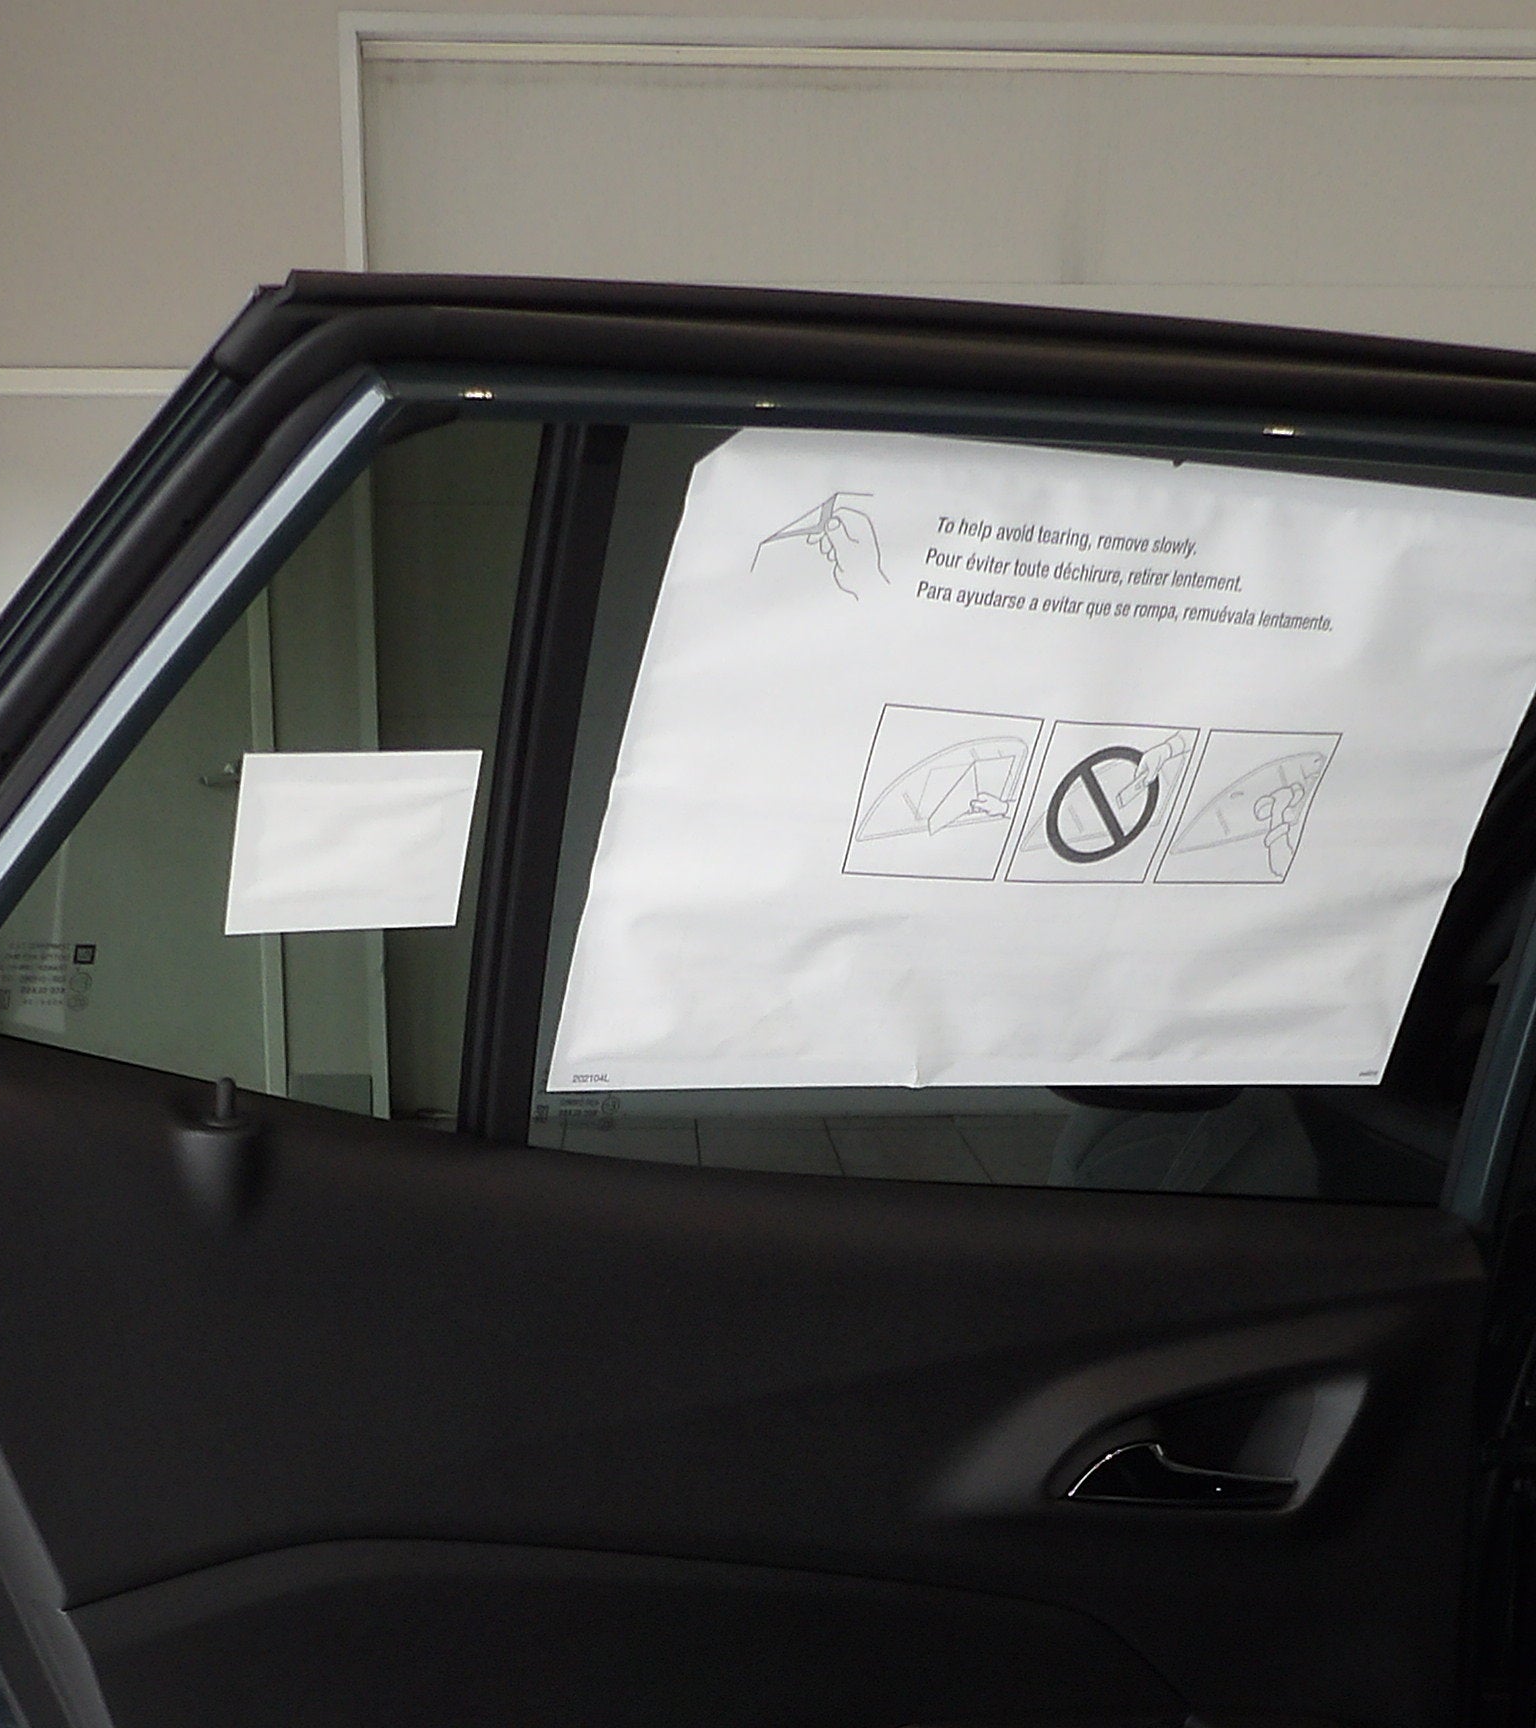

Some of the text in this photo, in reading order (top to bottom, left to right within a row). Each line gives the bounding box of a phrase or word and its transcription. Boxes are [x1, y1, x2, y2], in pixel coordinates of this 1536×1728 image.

[937, 517, 1197, 559] To help avoid tearing, remove slowly.
[925, 547, 1242, 592] Pour éviter toute déchirure, retirer lentement.
[916, 581, 1333, 631] Para ayudarse a evitar que se rompa, remuévala lentamente.
